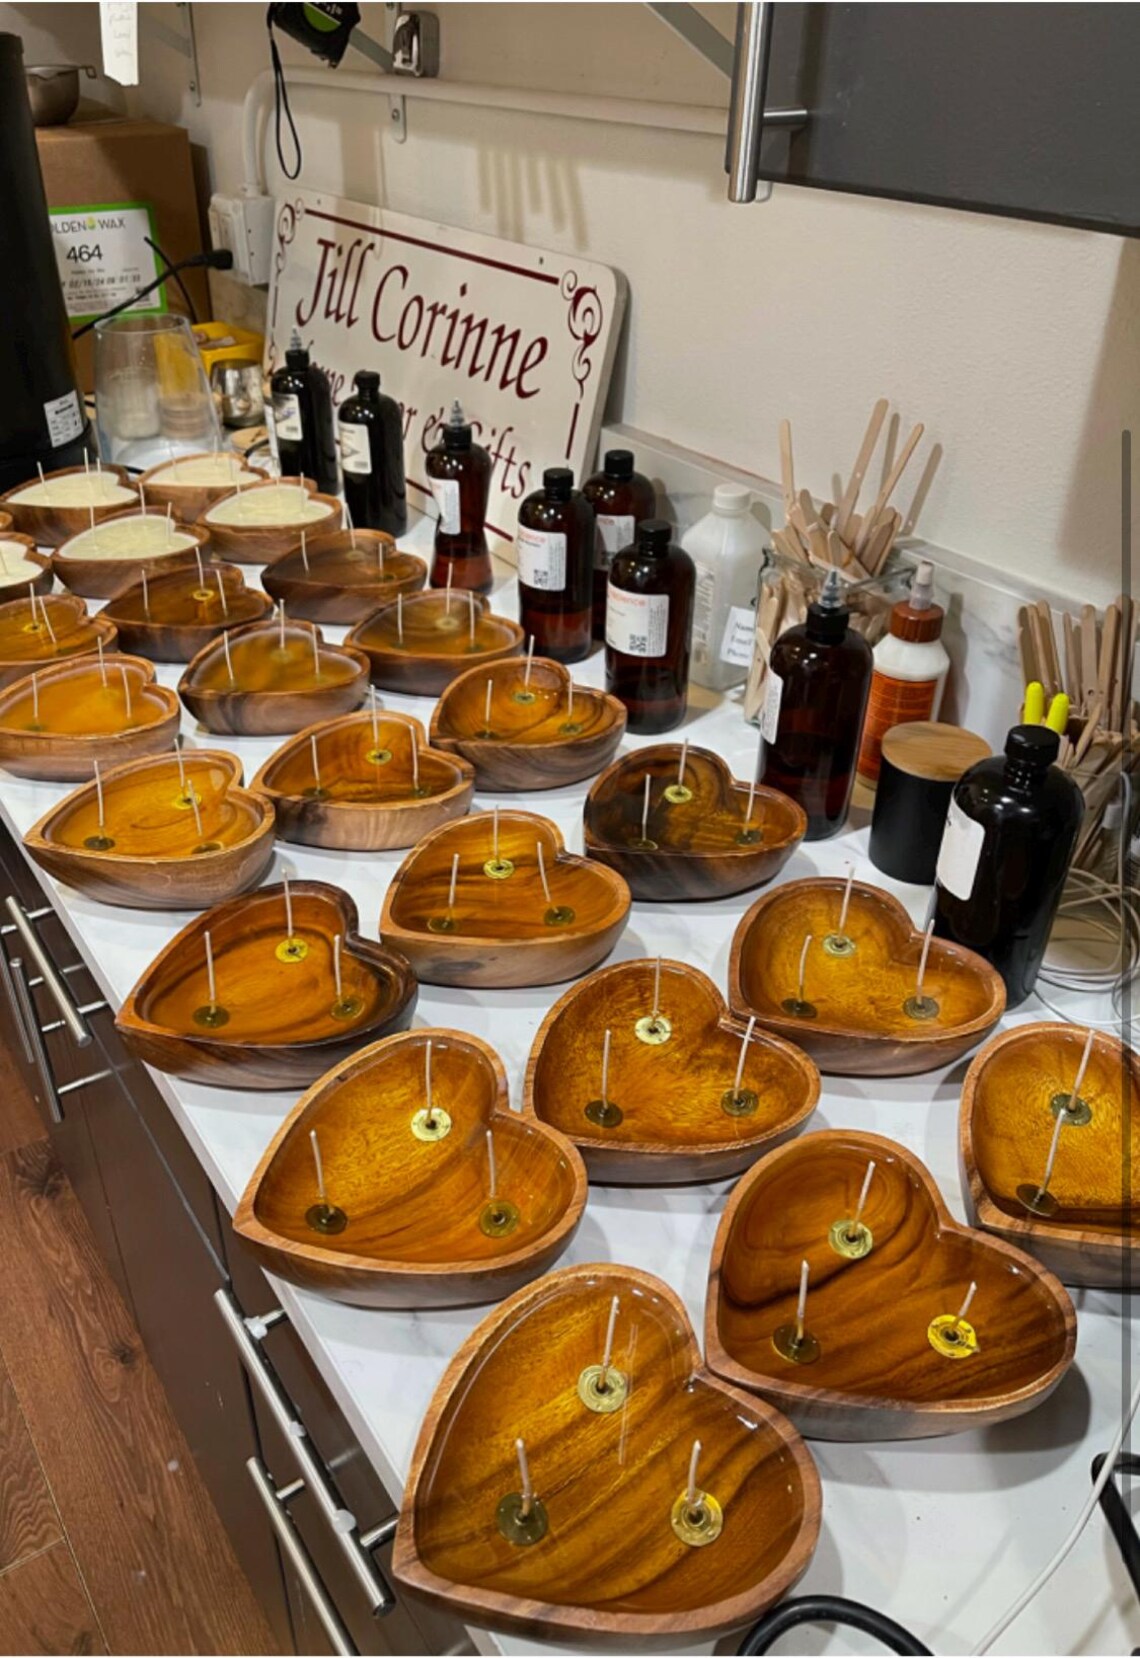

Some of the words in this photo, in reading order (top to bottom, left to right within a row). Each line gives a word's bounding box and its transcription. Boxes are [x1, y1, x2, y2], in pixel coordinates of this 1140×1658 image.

[97, 217, 126, 230] WAX
[67, 244, 102, 262] 464
[296, 237, 375, 329] Jill
[371, 264, 548, 400] Corinne
